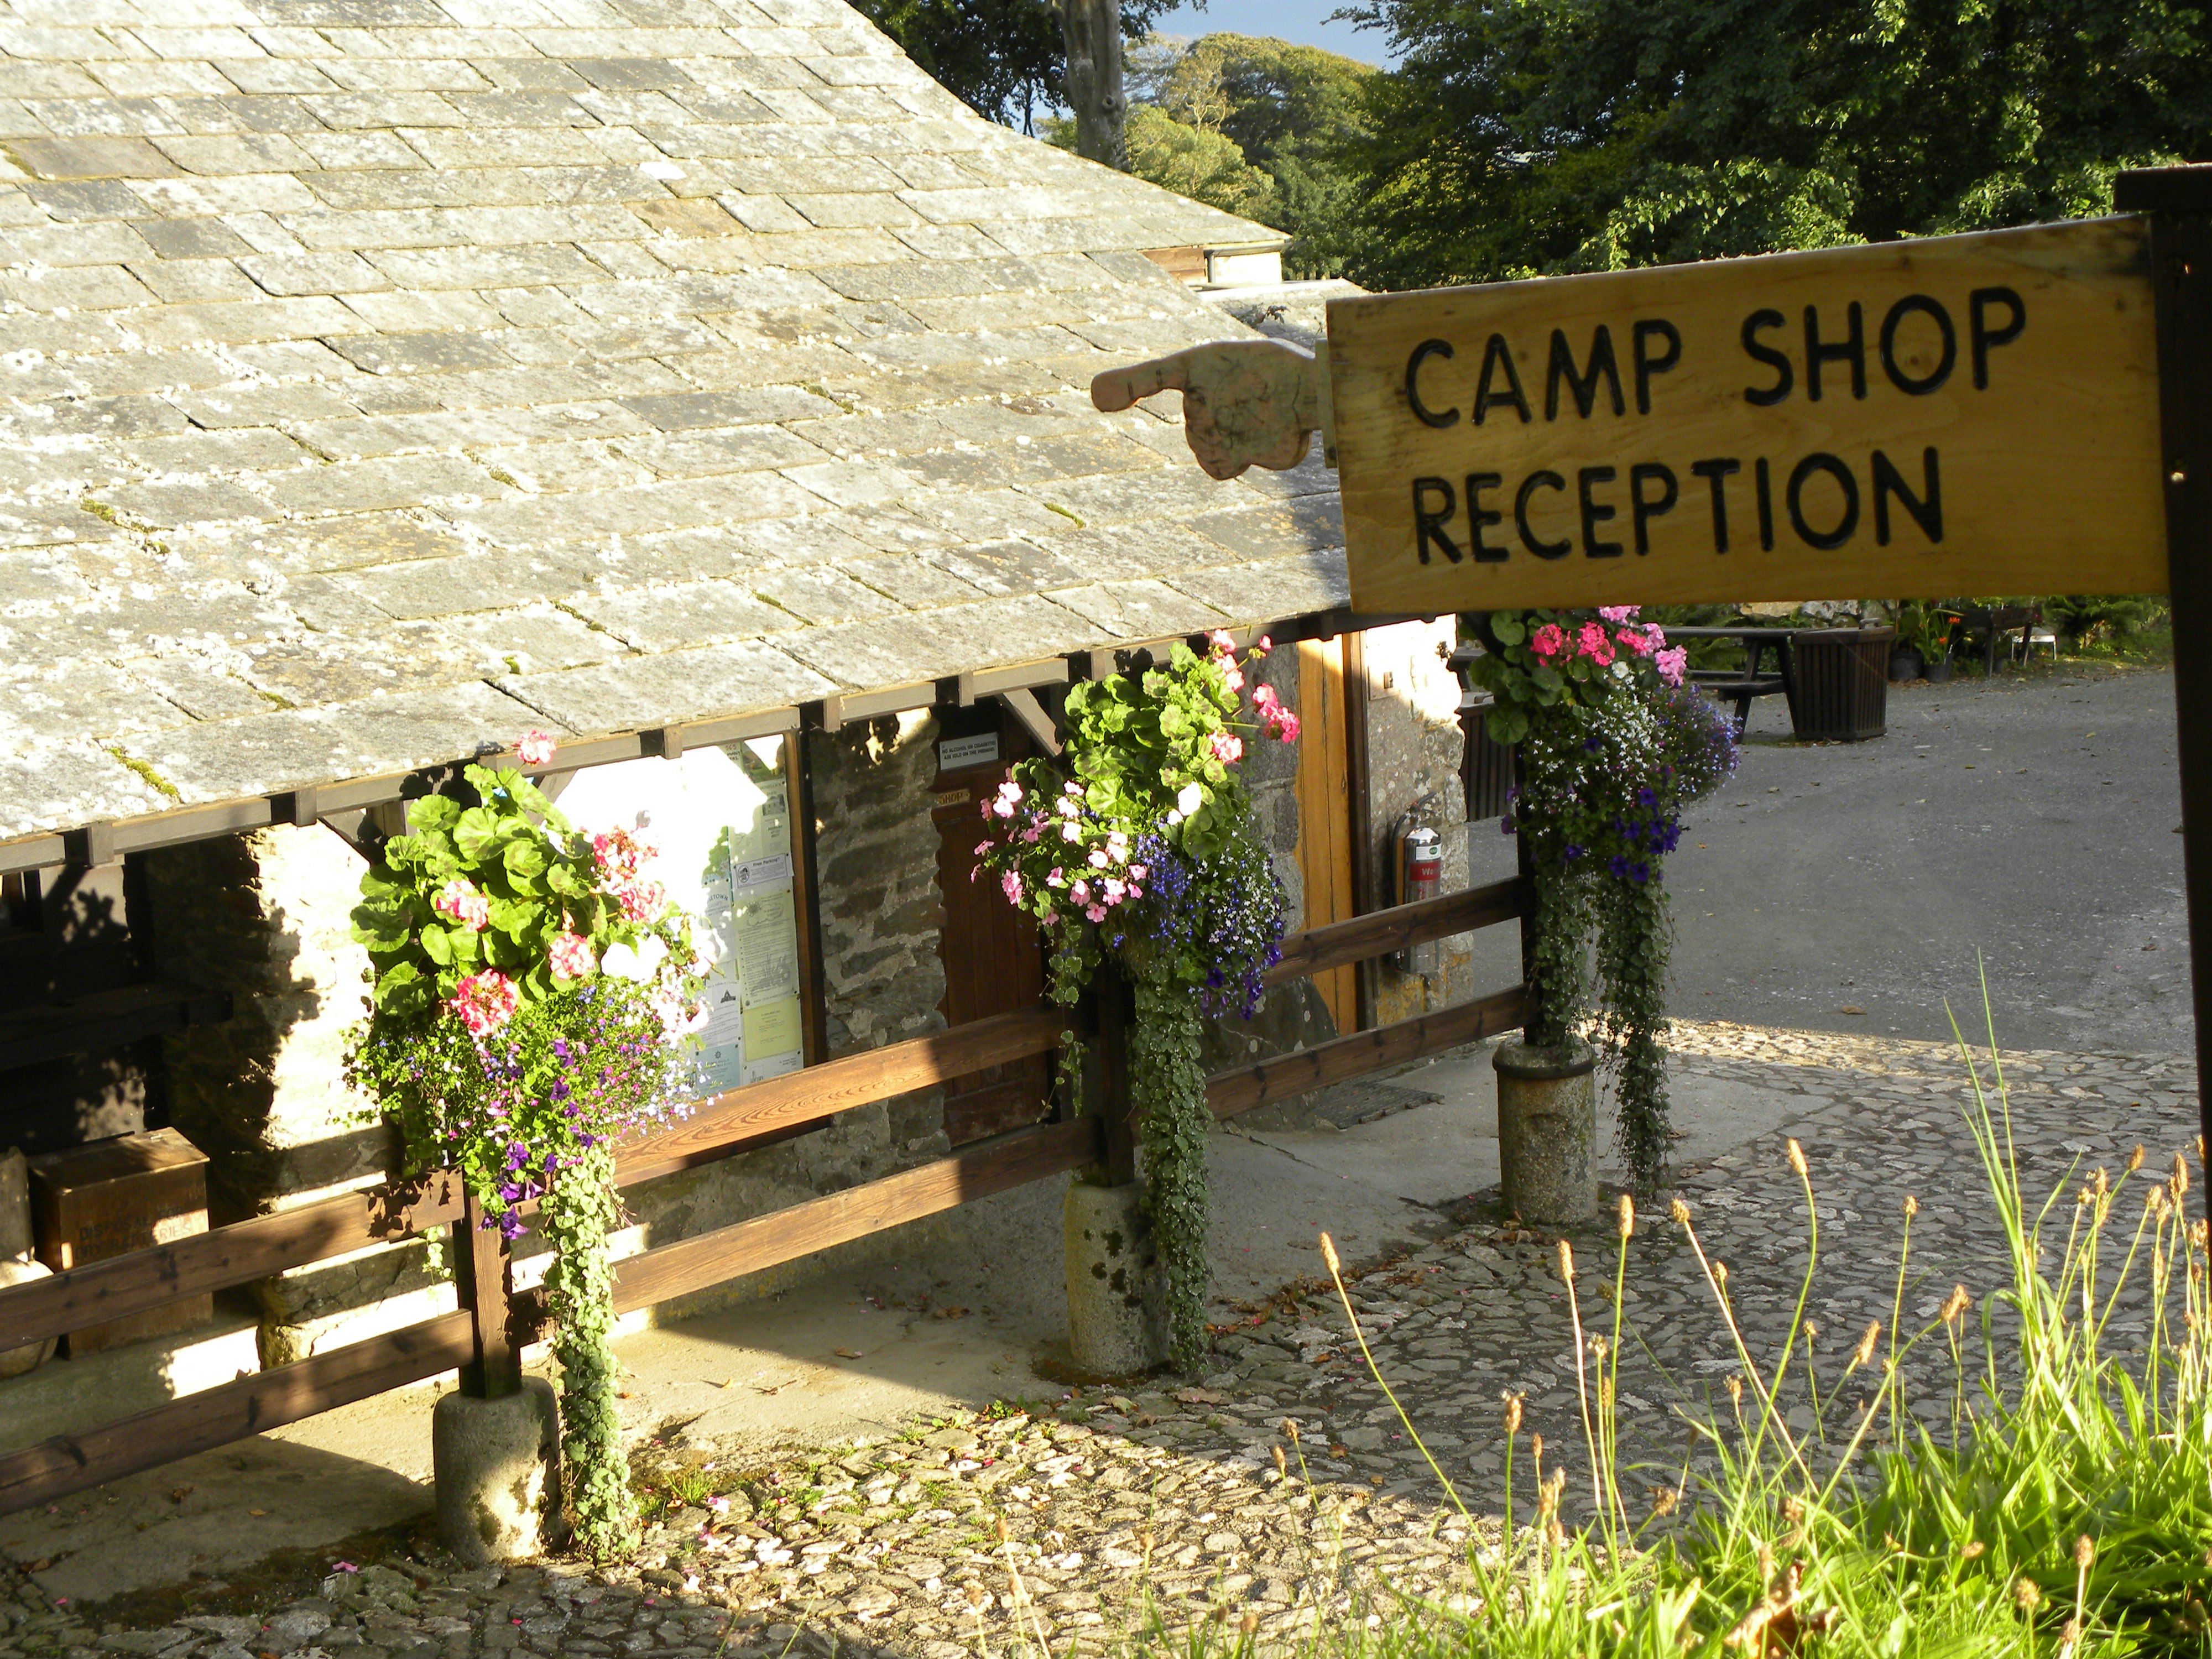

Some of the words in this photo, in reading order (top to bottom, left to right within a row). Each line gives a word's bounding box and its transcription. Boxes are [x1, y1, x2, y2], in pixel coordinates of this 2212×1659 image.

[1405, 319, 1682, 429] CAMP
[1741, 286, 2027, 406] SHOP
[1412, 446, 1944, 565] RECEPTION
[79, 1217, 150, 1241] DISPOSAL
